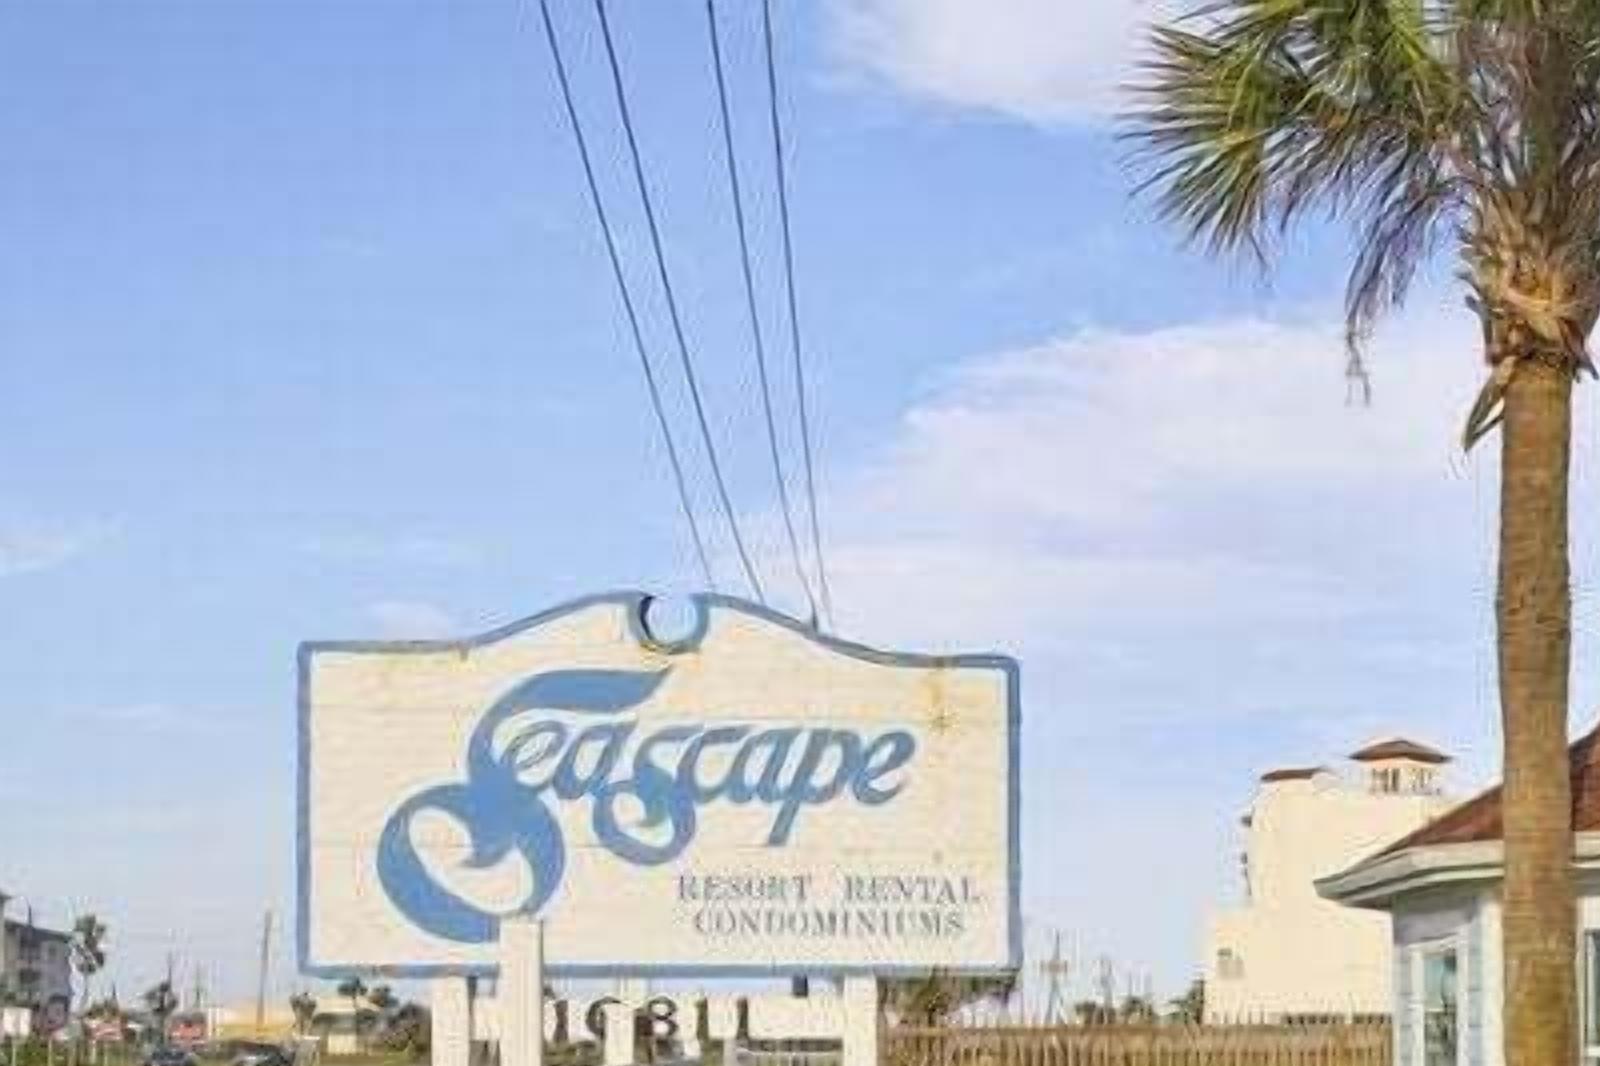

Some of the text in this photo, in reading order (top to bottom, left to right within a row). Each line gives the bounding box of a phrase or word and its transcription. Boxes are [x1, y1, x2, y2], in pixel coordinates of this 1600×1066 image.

[678, 873, 981, 904] RESORT RENTAL
[694, 907, 966, 937] CONDOMINIUMS
